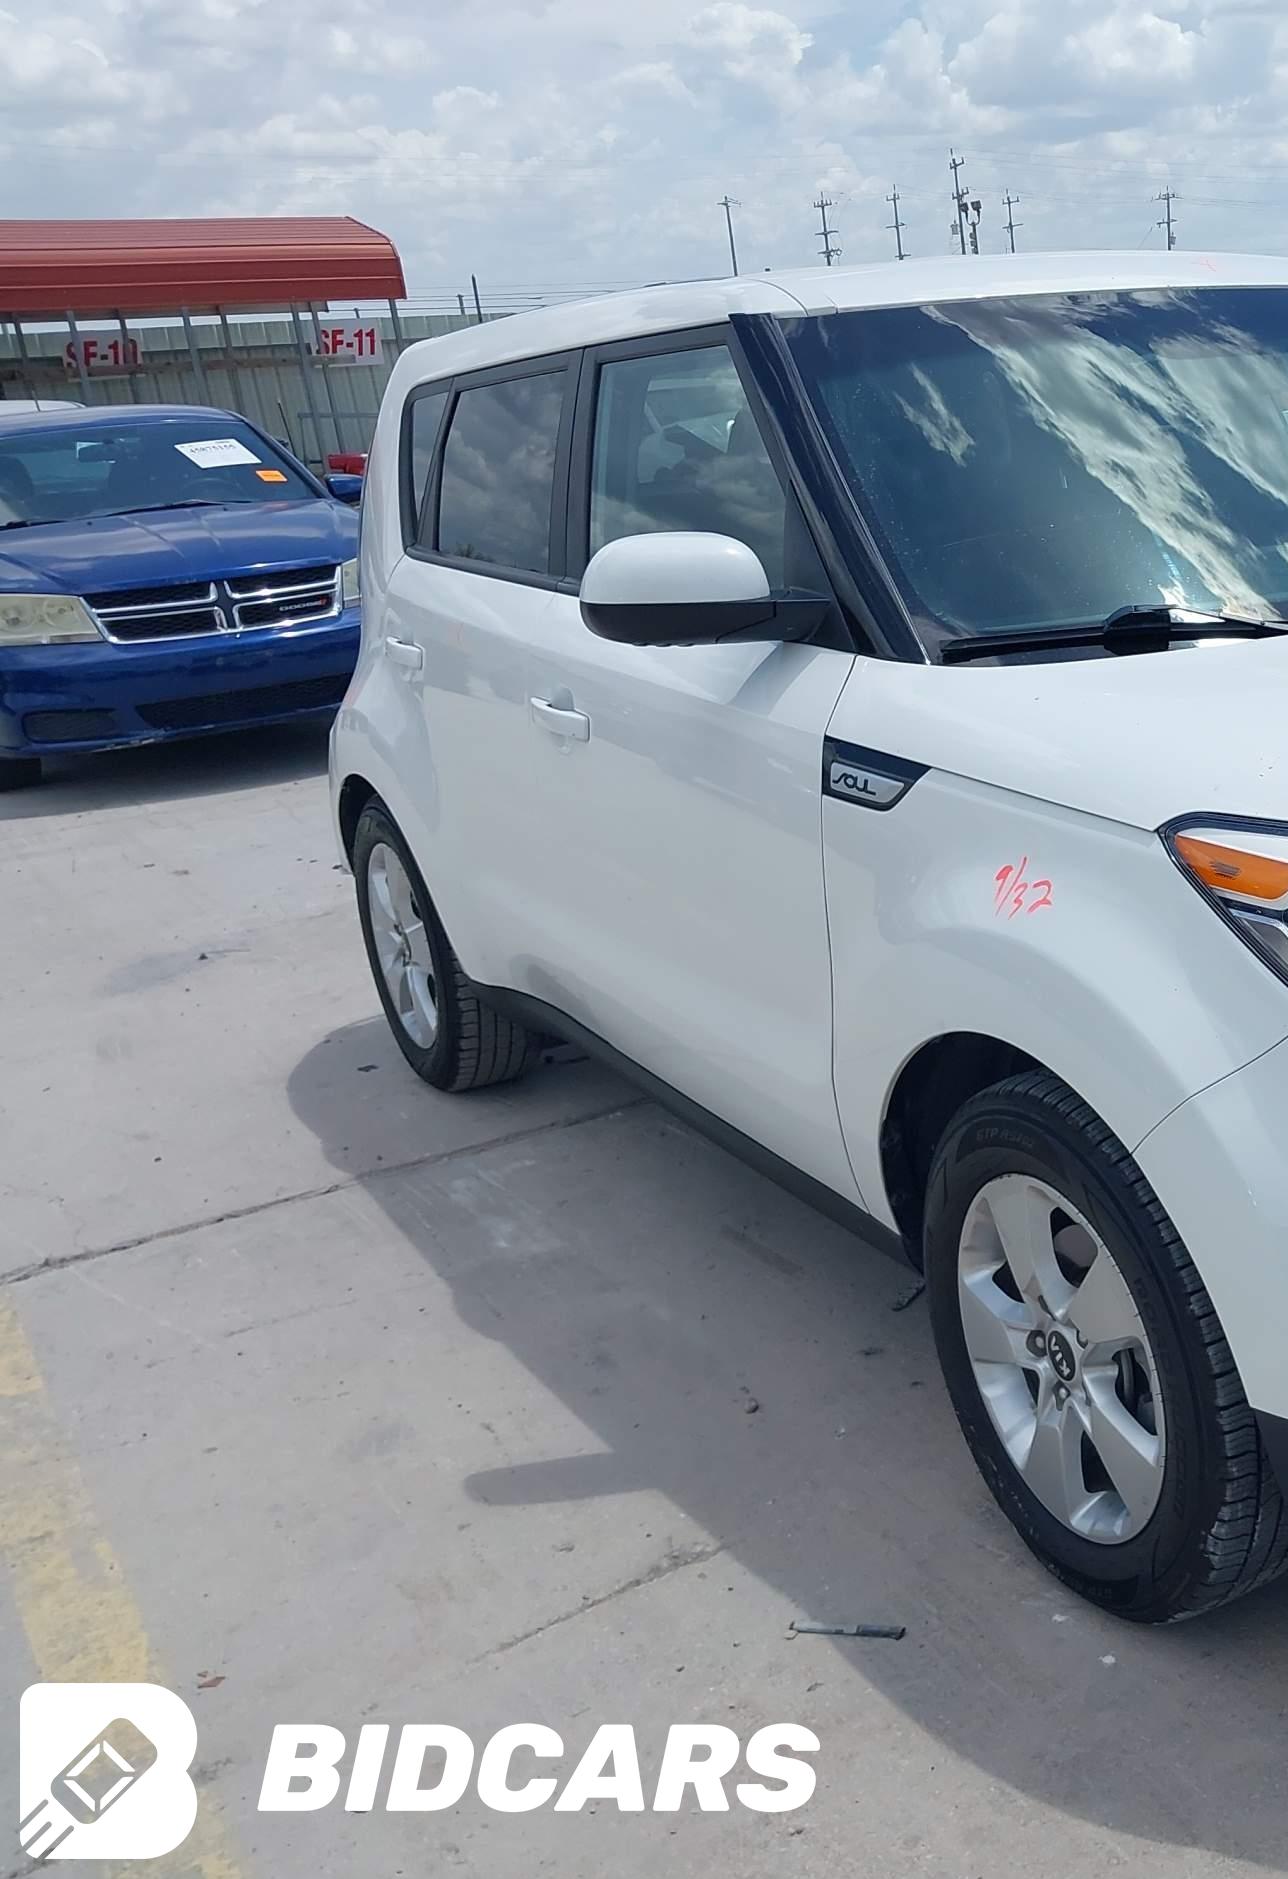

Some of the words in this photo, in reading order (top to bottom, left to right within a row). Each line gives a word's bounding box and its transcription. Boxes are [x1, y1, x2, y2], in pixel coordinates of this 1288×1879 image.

[315, 327, 376, 356] SF-11
[832, 773, 877, 796] SOUL
[1050, 1335, 1071, 1378] KIA
